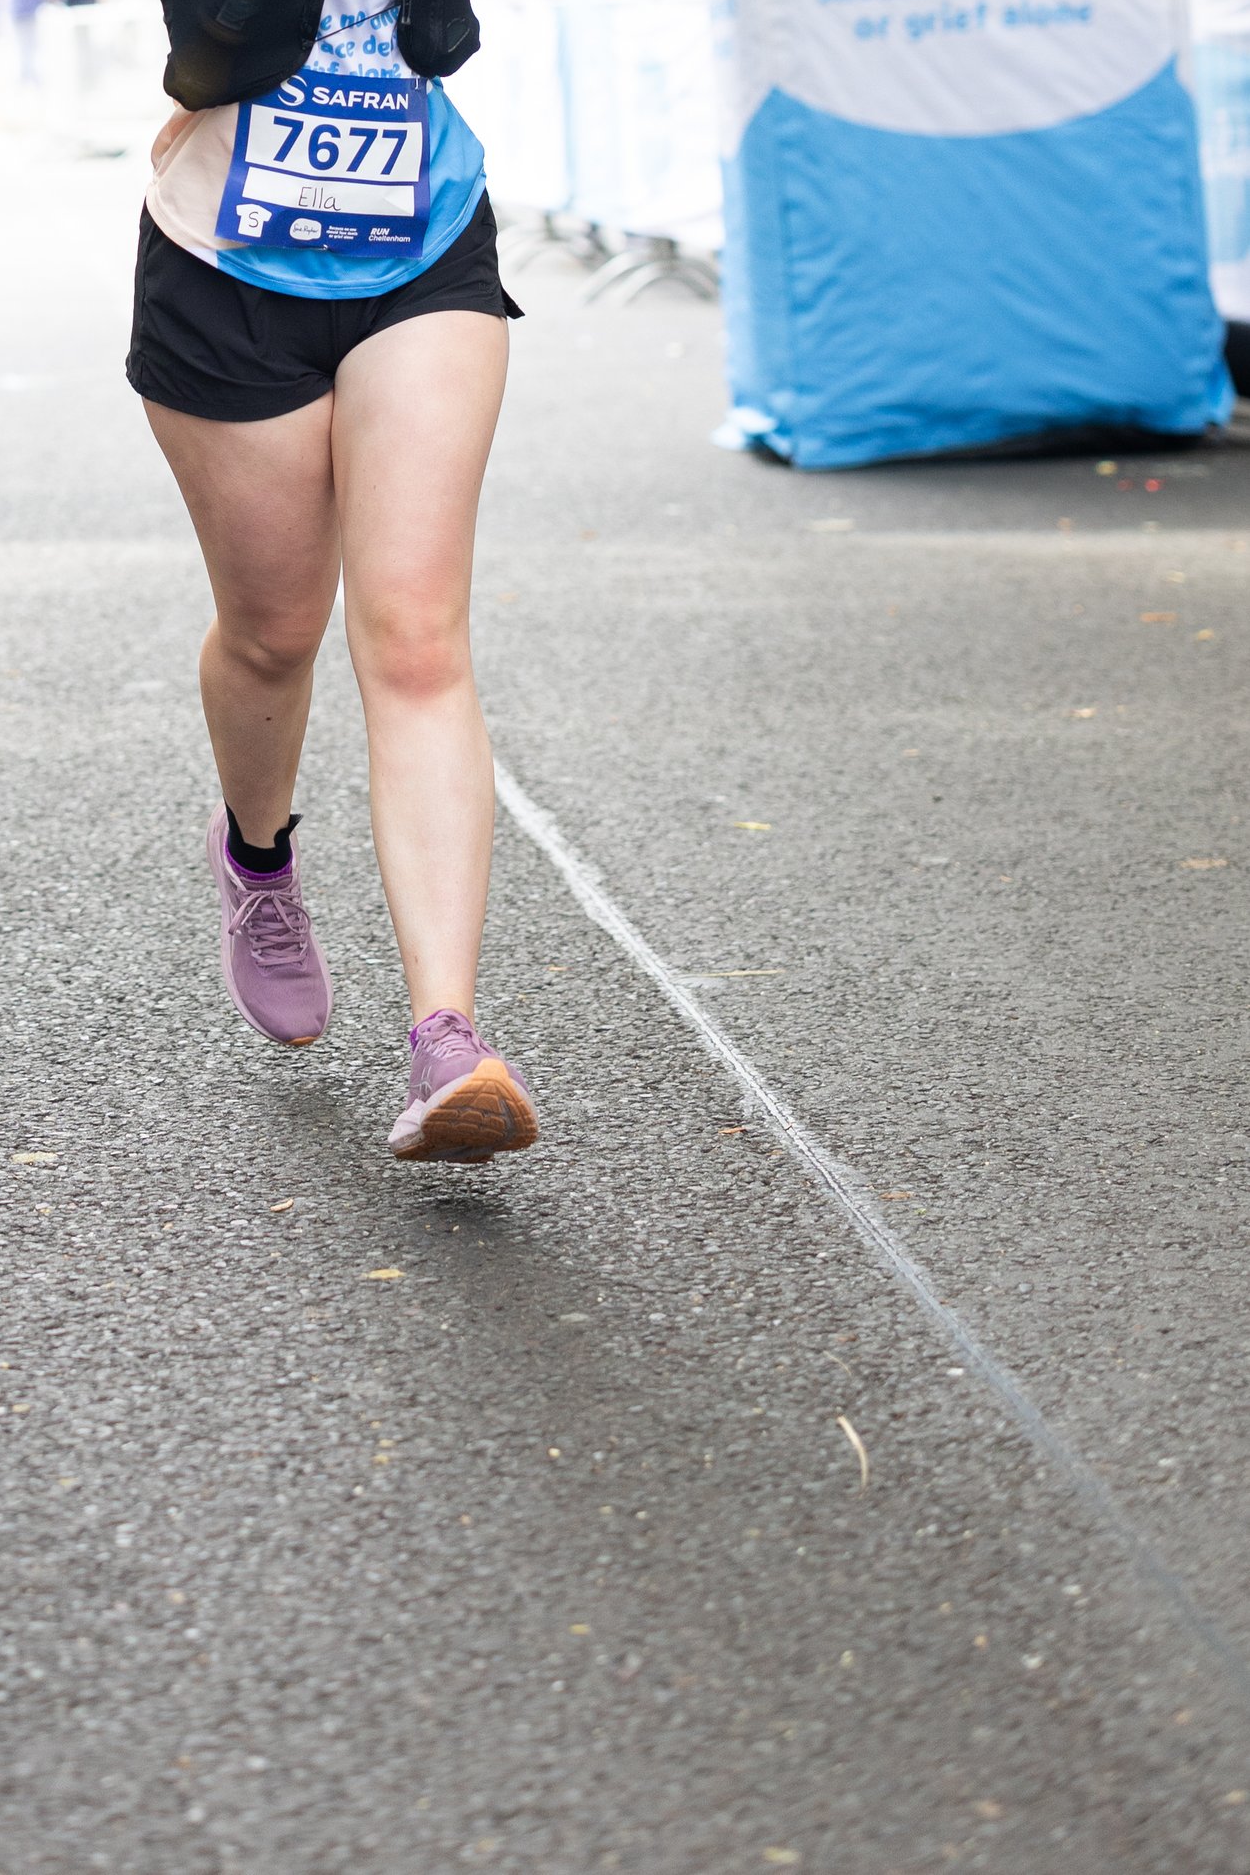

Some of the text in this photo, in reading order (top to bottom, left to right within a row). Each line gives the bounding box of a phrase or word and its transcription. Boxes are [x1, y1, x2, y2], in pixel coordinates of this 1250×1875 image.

[854, 0, 1092, 41] or grief alone
[311, 86, 409, 110] SAFRAN
[273, 115, 408, 175] 7677
[298, 186, 342, 212] Ella
[248, 211, 259, 228] S
